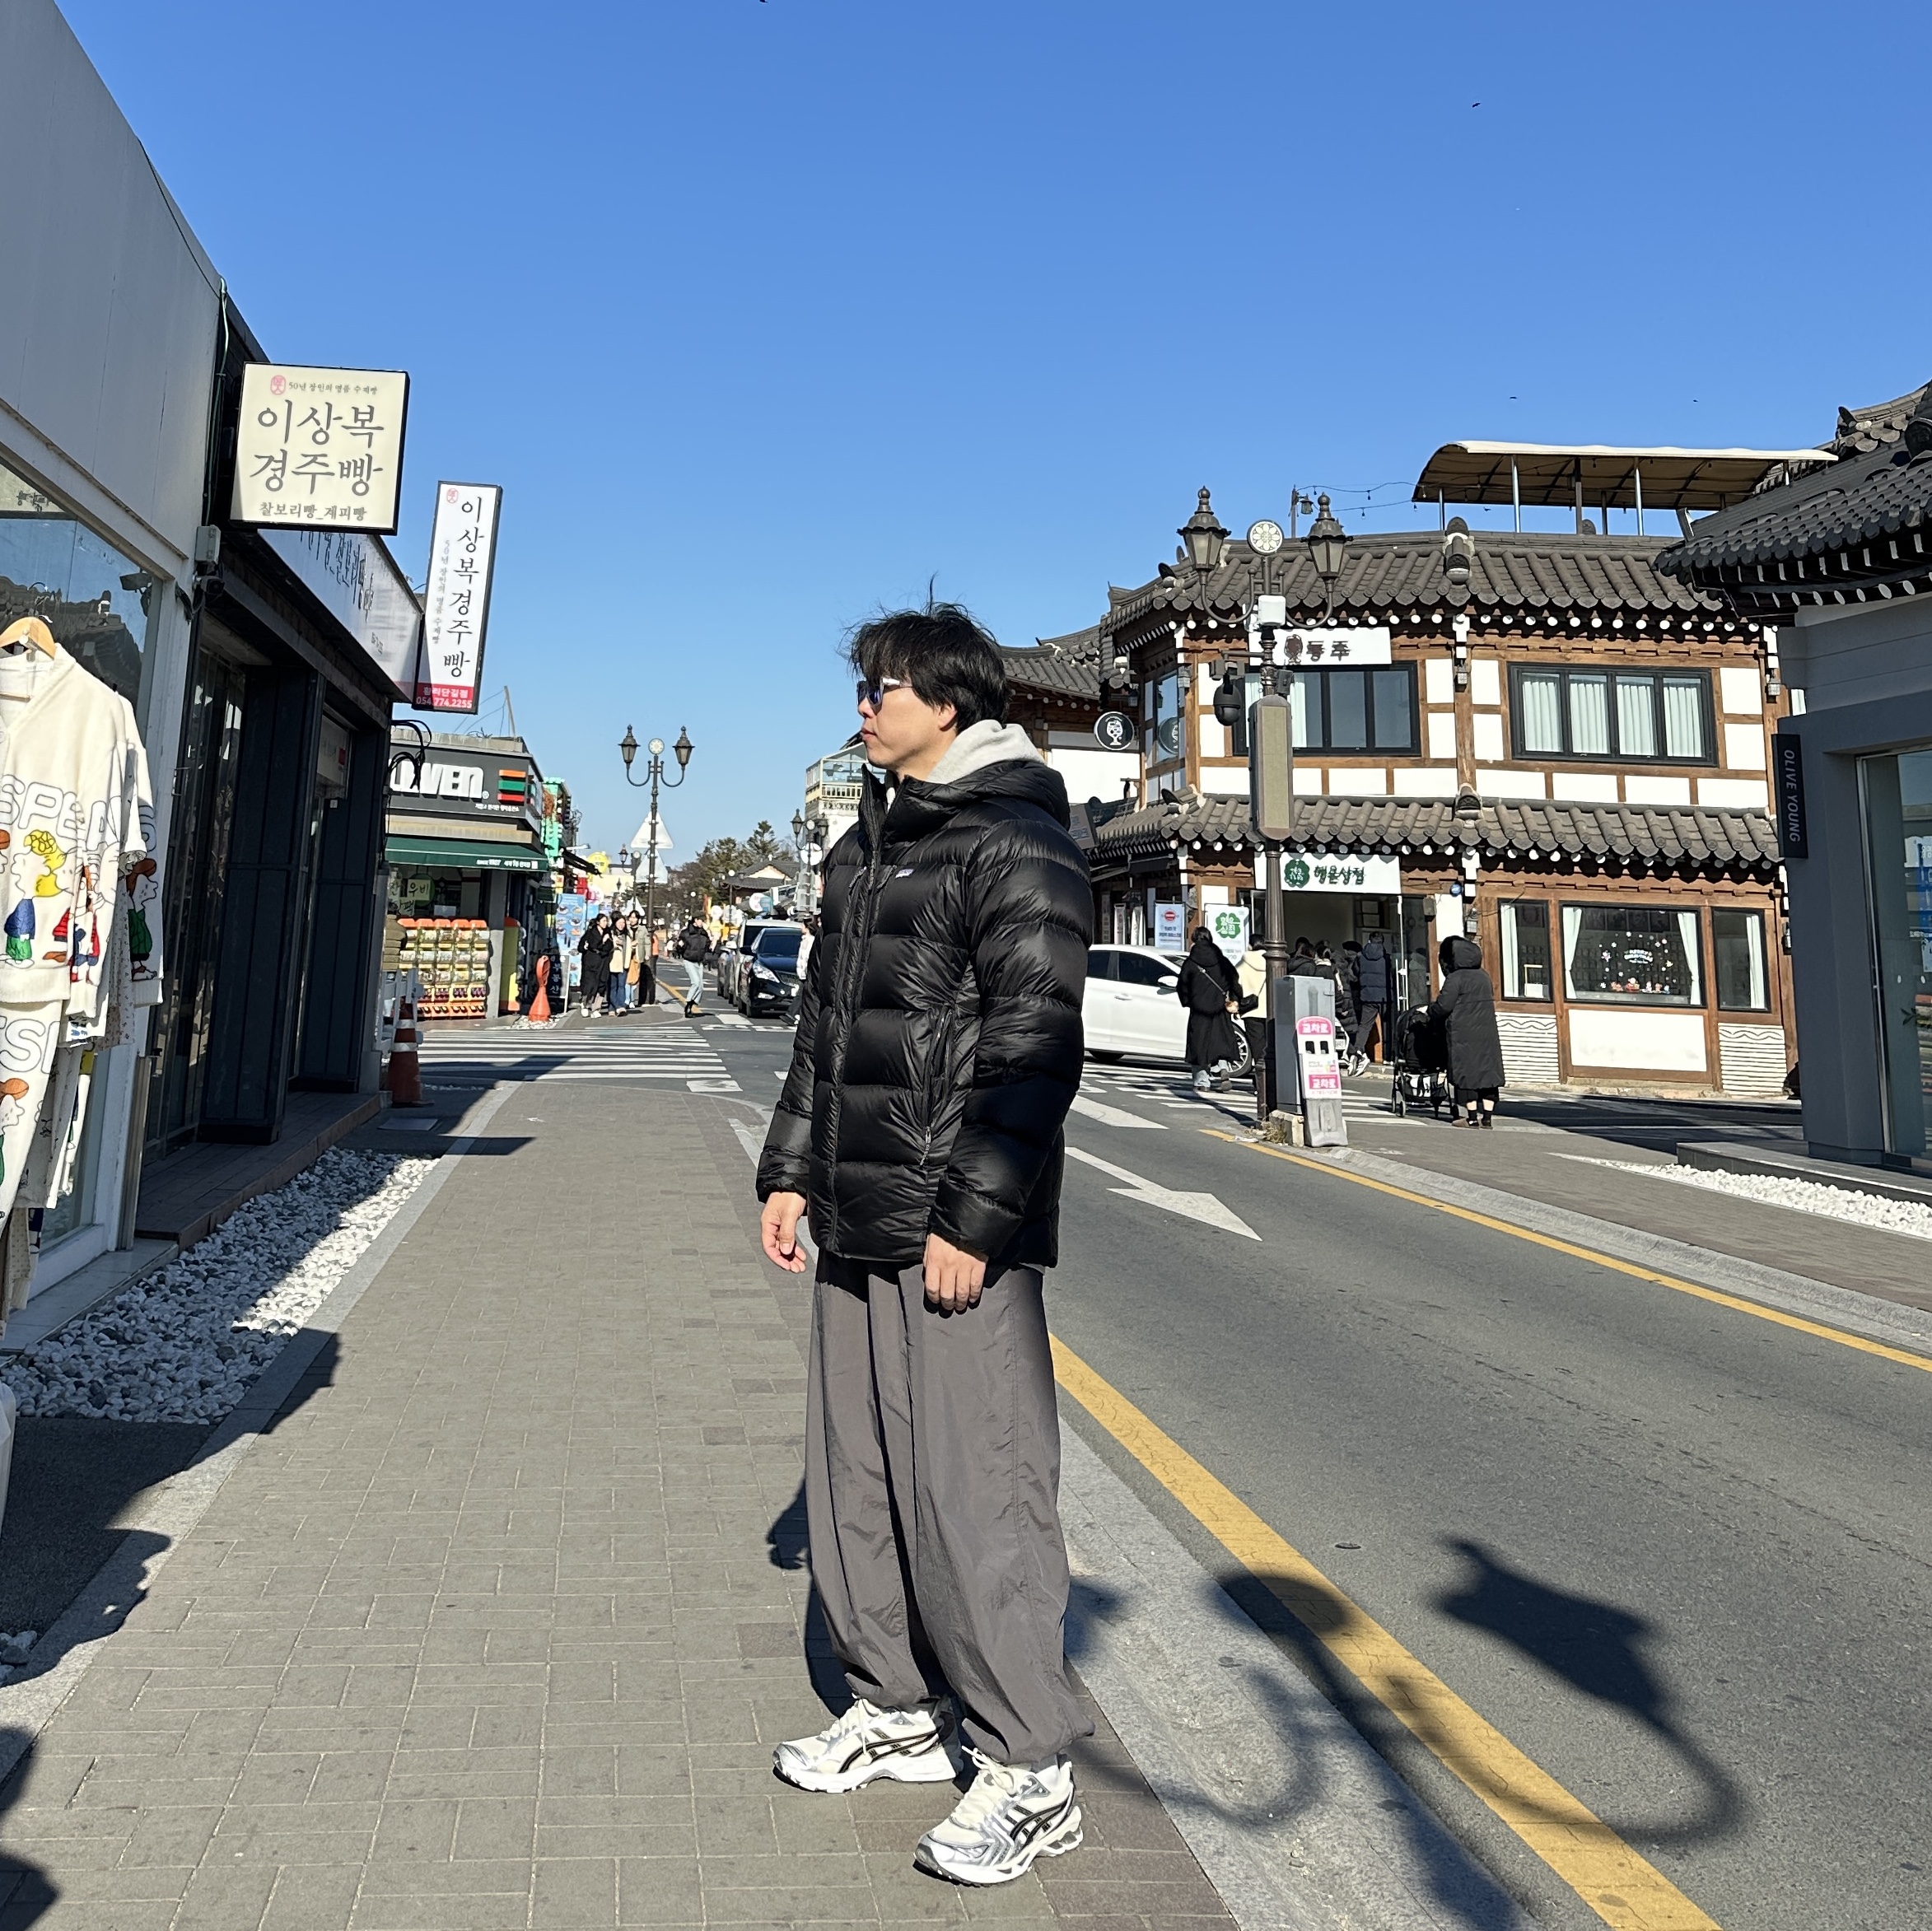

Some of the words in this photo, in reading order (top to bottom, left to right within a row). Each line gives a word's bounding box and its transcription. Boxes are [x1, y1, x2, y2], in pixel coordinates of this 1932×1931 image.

[257, 399, 385, 449] 이상복
[250, 448, 384, 497] 경주빵
[1784, 749, 1797, 791] OLIVE
[1787, 795, 1801, 842] YOUNG
[408, 882, 429, 897] 우비
[1302, 1023, 1329, 1033] 교차로
[1312, 1078, 1337, 1089] 교차로
